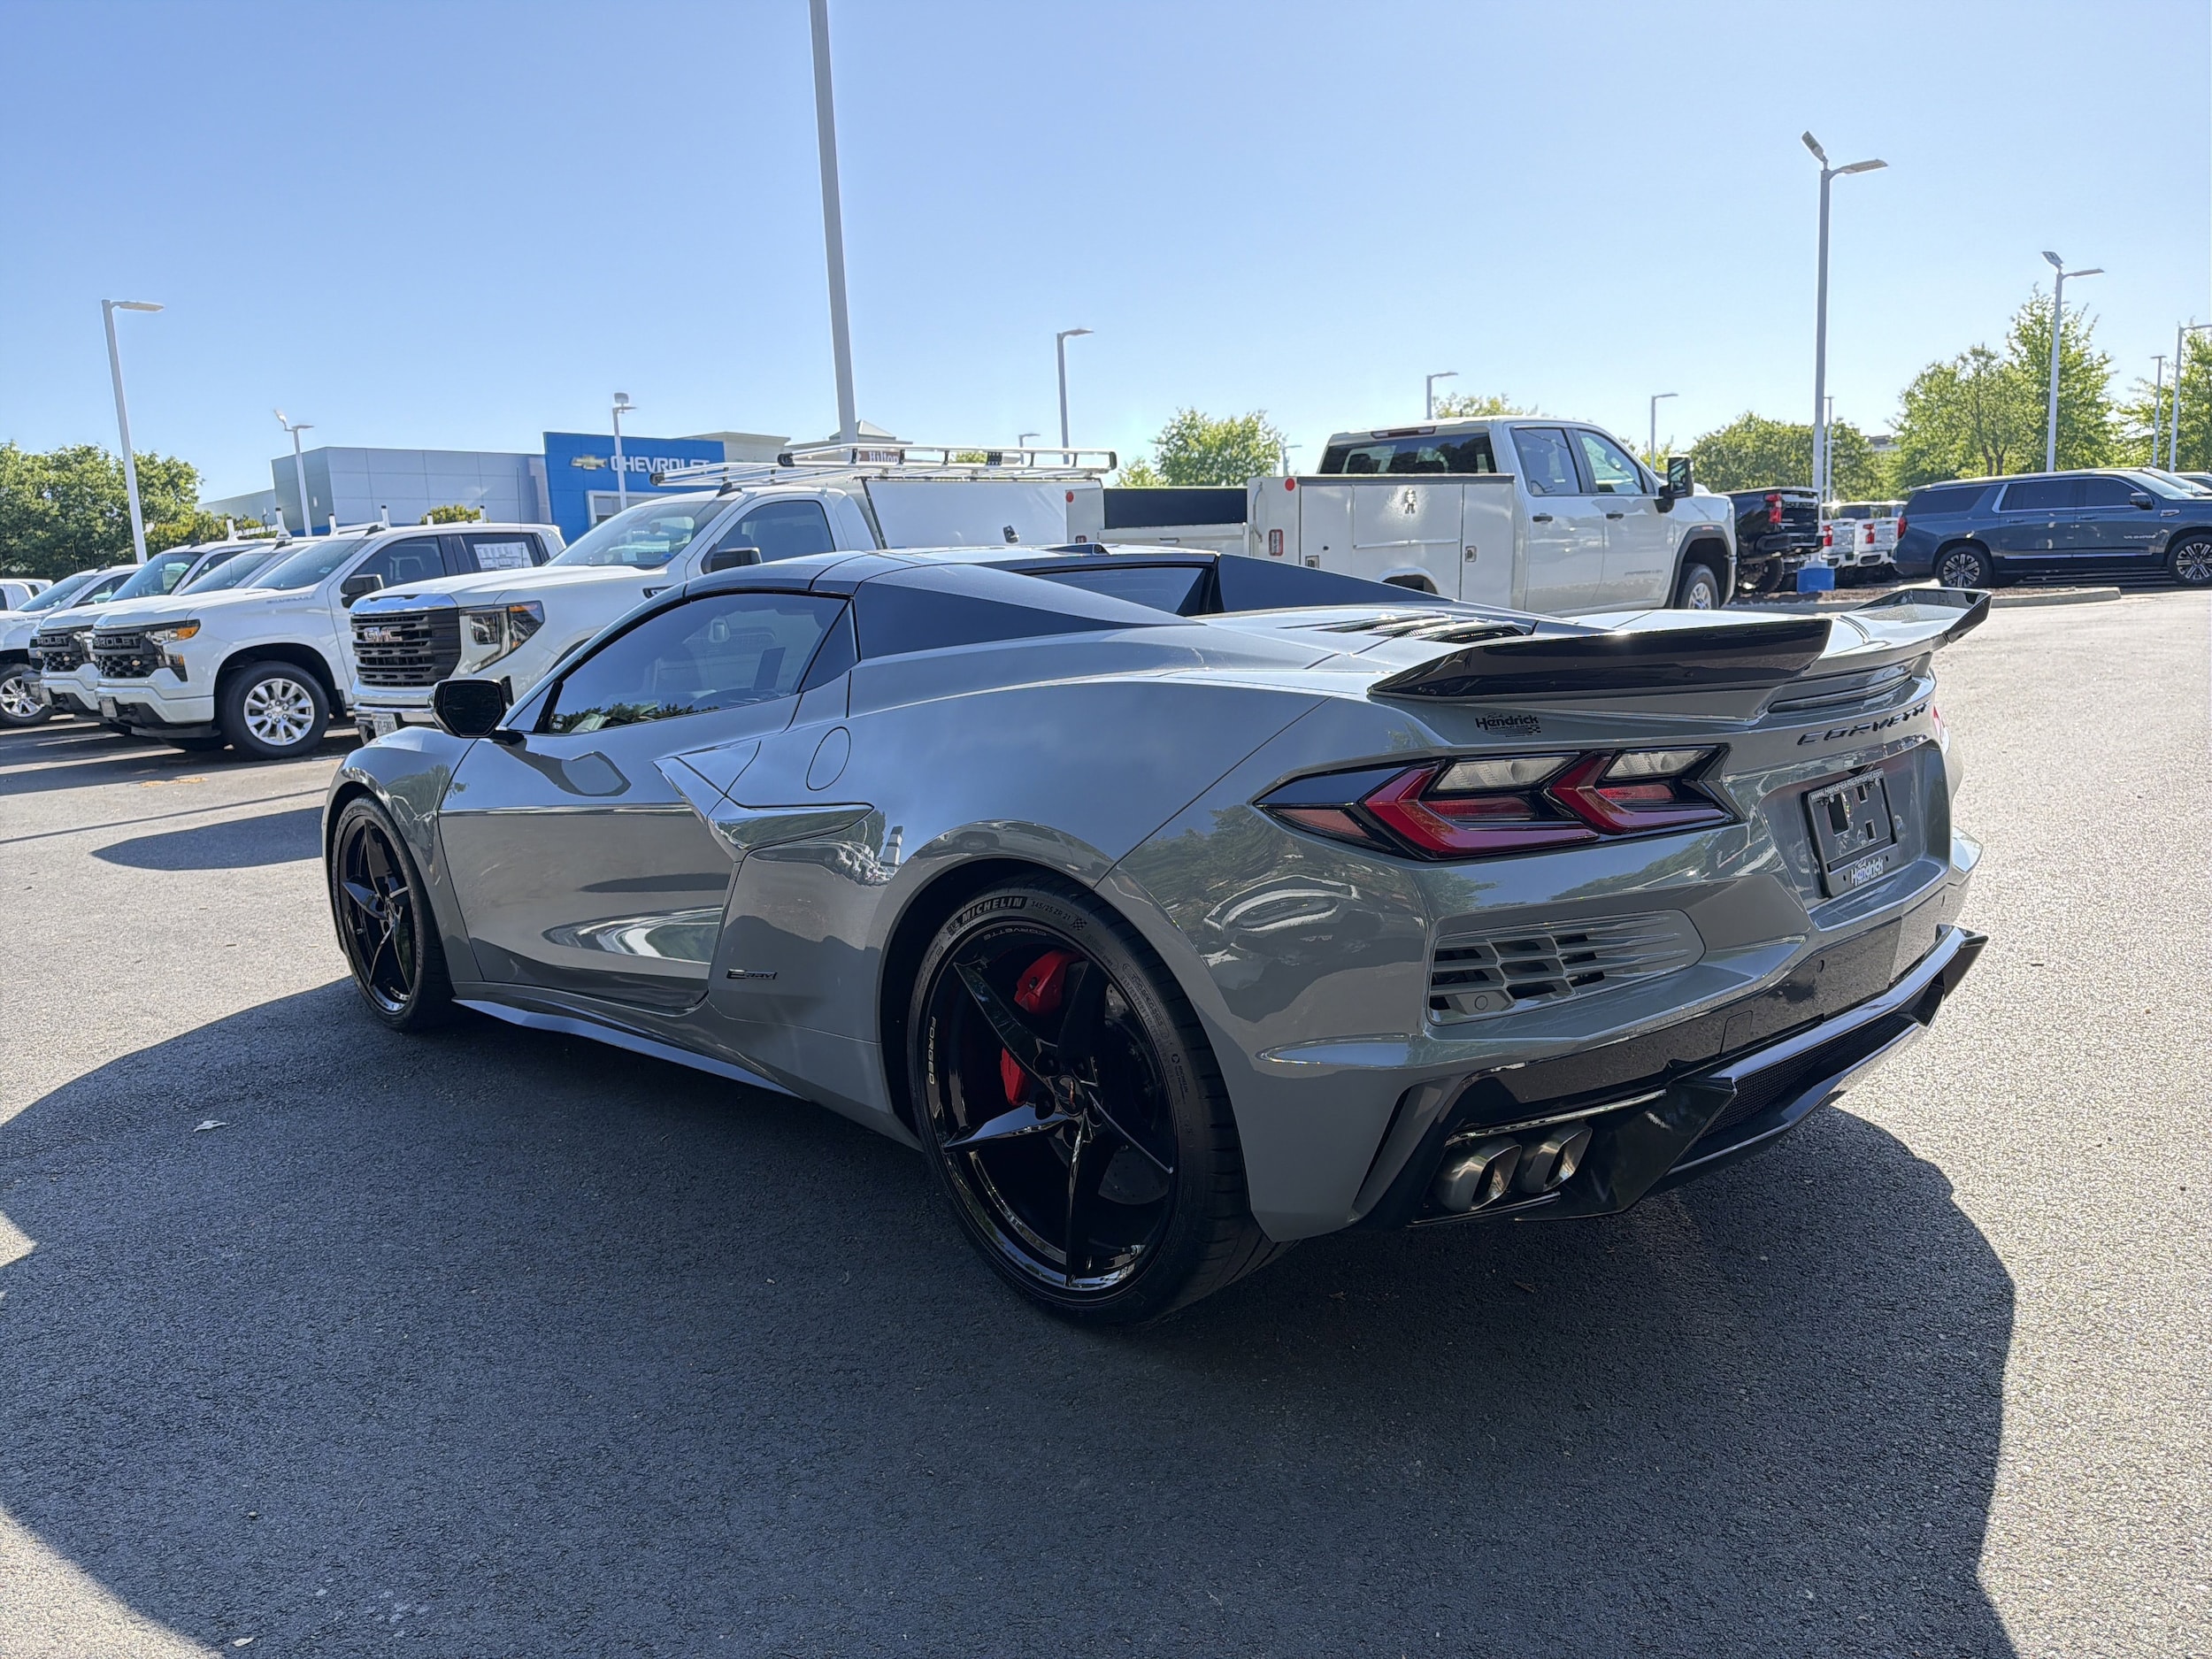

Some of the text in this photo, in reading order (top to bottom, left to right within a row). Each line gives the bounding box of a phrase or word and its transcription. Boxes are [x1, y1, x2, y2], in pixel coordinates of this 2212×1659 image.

[869, 450, 899, 463] Hilton
[364, 626, 403, 642] GMC
[1475, 714, 1540, 731] Hendrick
[962, 896, 1024, 923] MICHELIN
[928, 1016, 937, 1085] FORGED
